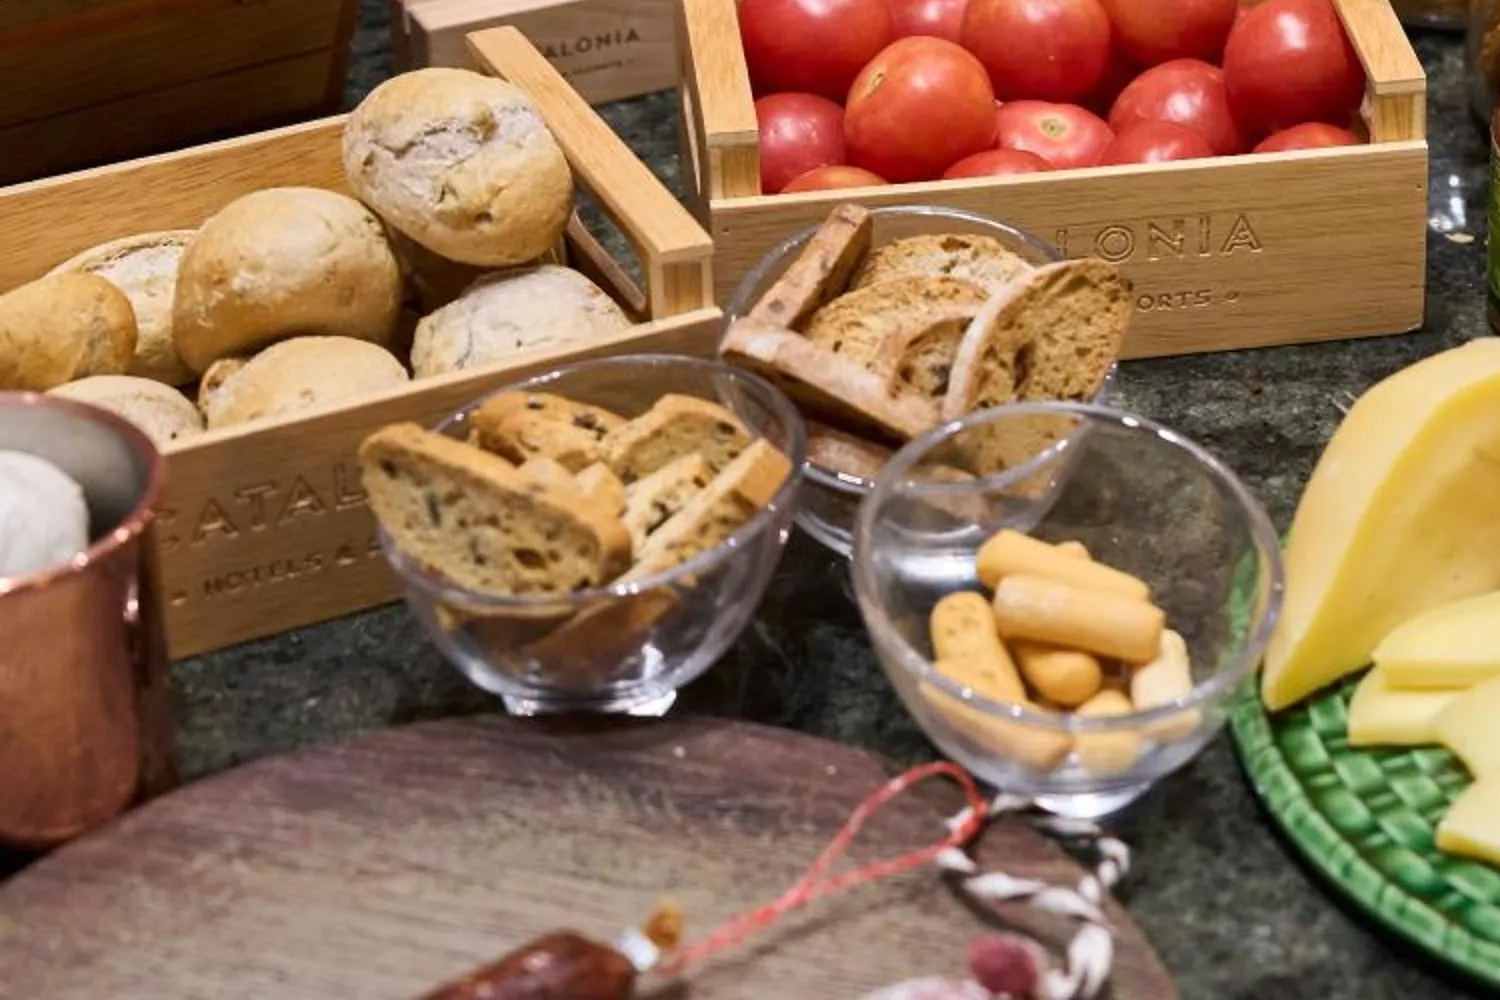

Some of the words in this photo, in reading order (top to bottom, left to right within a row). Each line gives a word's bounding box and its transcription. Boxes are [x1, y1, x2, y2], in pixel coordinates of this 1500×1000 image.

[538, 29, 642, 59] ALONIA
[1136, 289, 1212, 311] ORTS
[154, 461, 368, 549] CATAL
[203, 553, 322, 596] HOTELS
